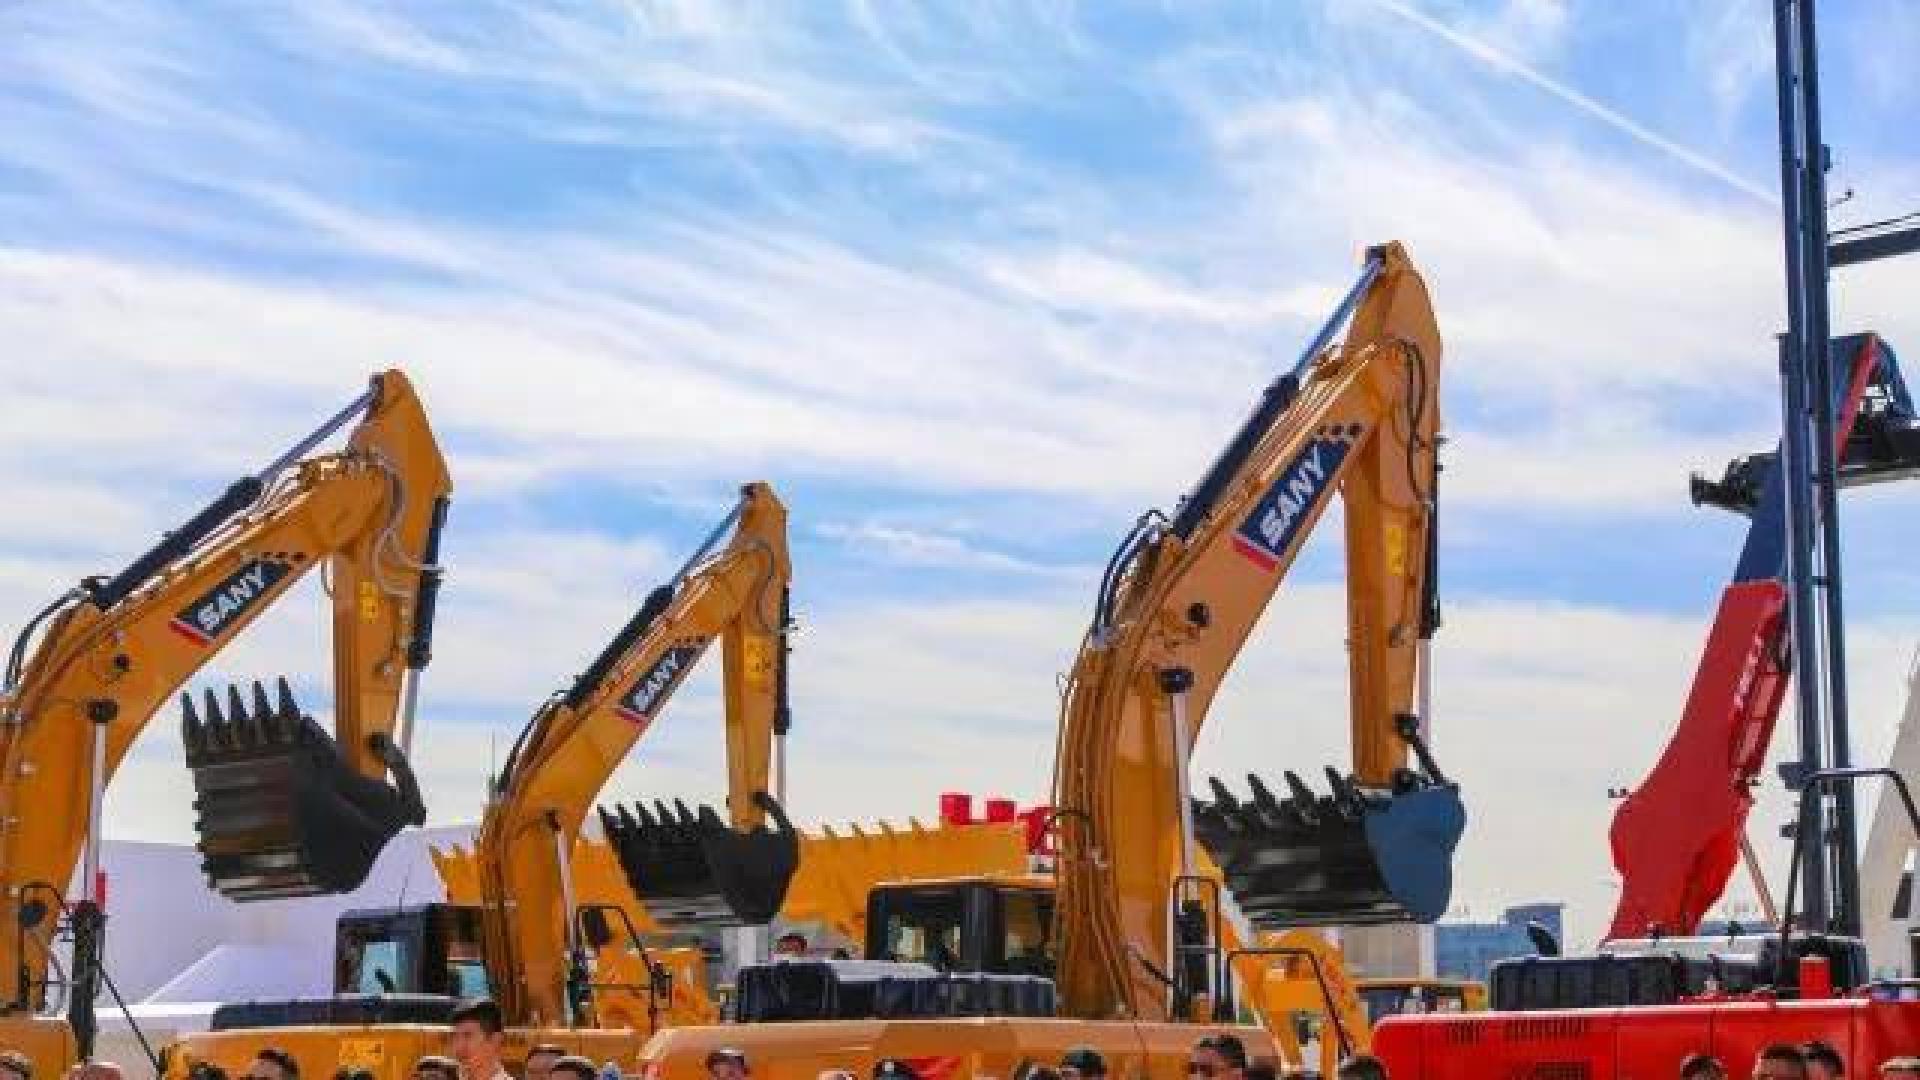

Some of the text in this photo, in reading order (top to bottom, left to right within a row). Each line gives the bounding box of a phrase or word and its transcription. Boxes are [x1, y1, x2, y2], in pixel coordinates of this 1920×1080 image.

[1260, 444, 1323, 547] SANY
[197, 564, 265, 631] SANY
[633, 650, 679, 712] SANY
